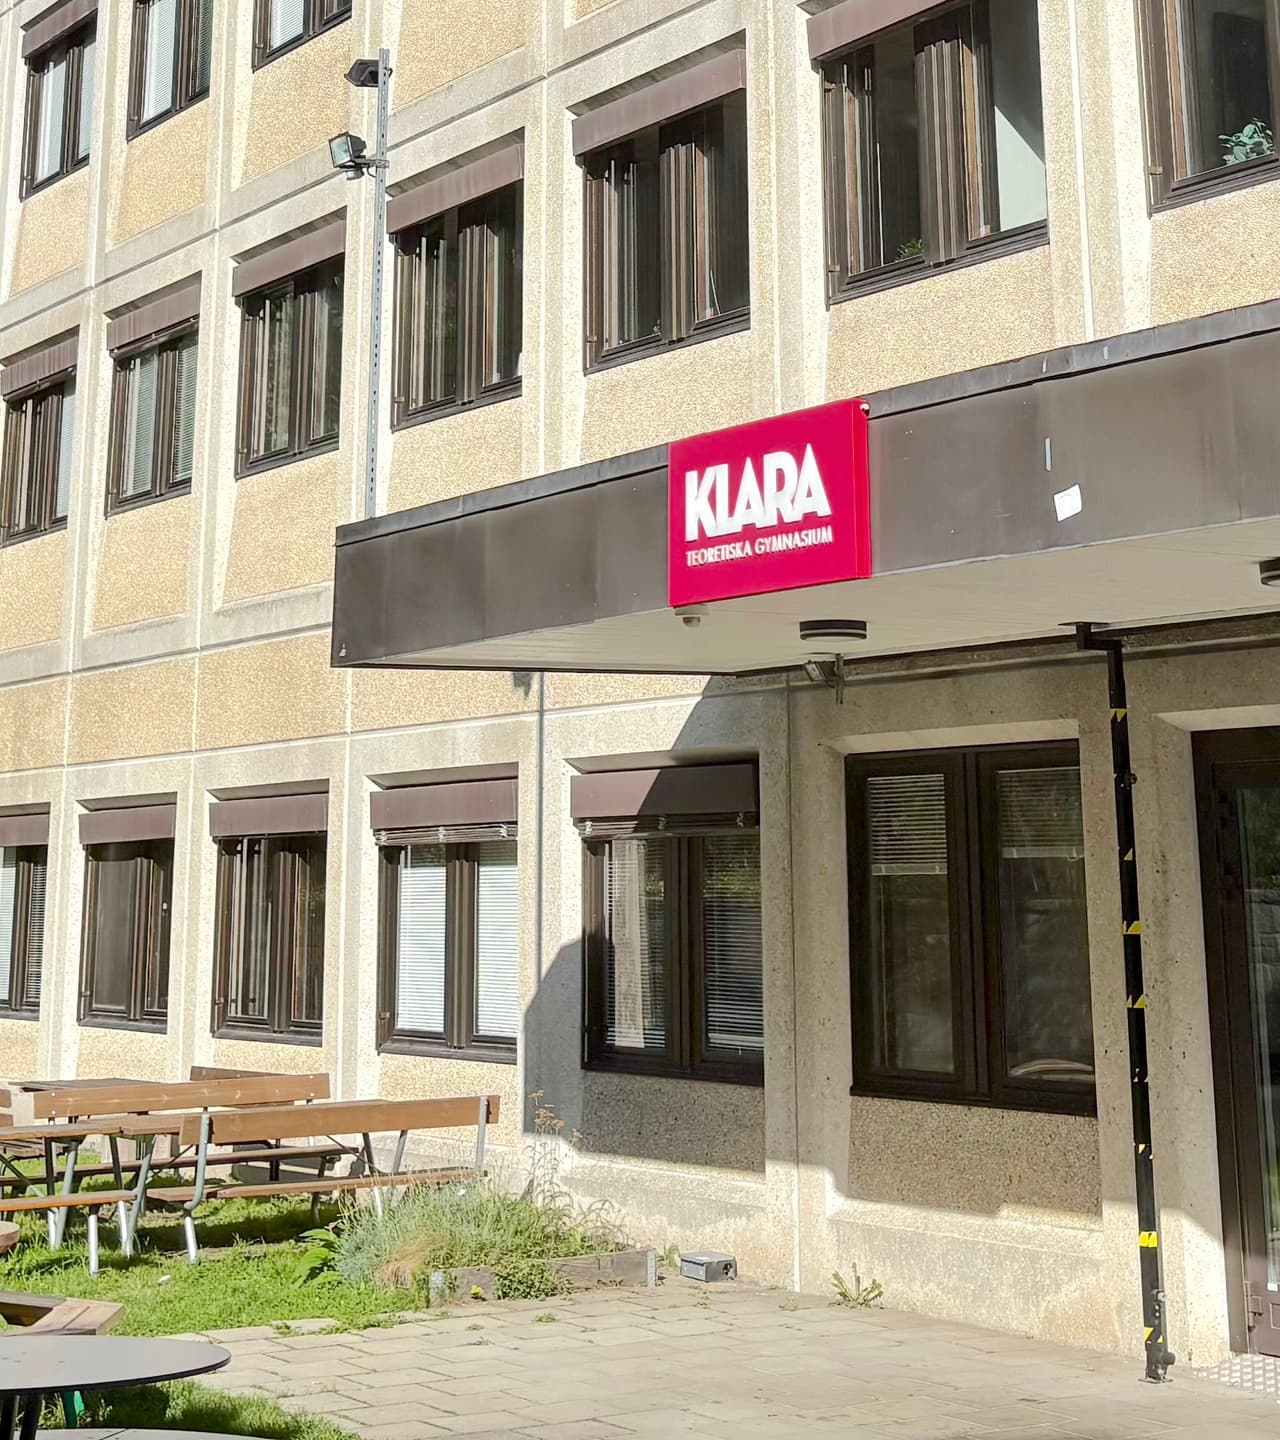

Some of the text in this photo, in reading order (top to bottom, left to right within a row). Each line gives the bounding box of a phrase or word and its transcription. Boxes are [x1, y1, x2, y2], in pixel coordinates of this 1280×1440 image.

[685, 443, 832, 542] KLARA
[686, 525, 833, 567] TEORETISKA GYMNASIUM
